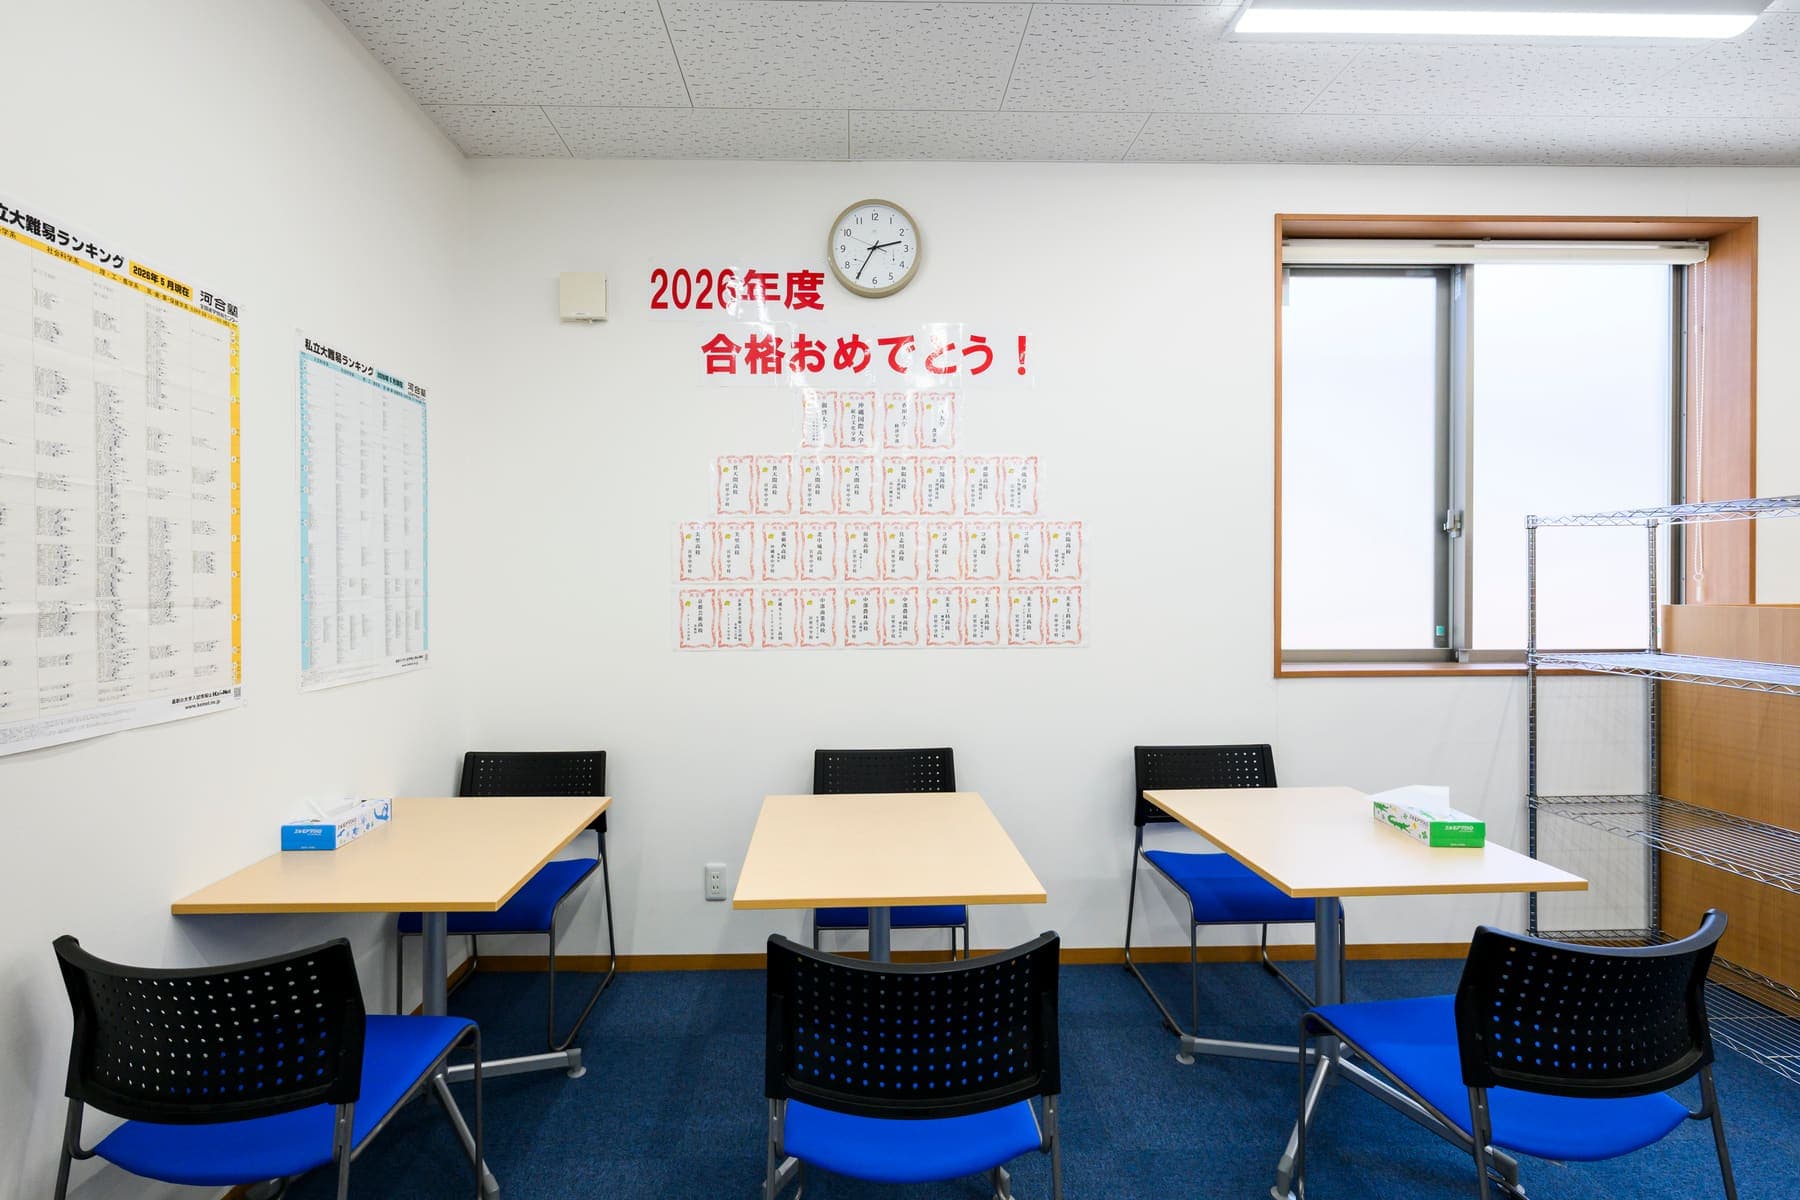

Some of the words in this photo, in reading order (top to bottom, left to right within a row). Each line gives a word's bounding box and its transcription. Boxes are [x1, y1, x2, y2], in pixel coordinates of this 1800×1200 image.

[872, 213, 879, 221] 12
[844, 229, 852, 237] 10
[900, 228, 904, 236] 2
[844, 261, 850, 269] 8
[889, 272, 893, 280] 5
[650, 268, 825, 310] 2026年度
[199, 289, 239, 318] 河合塾
